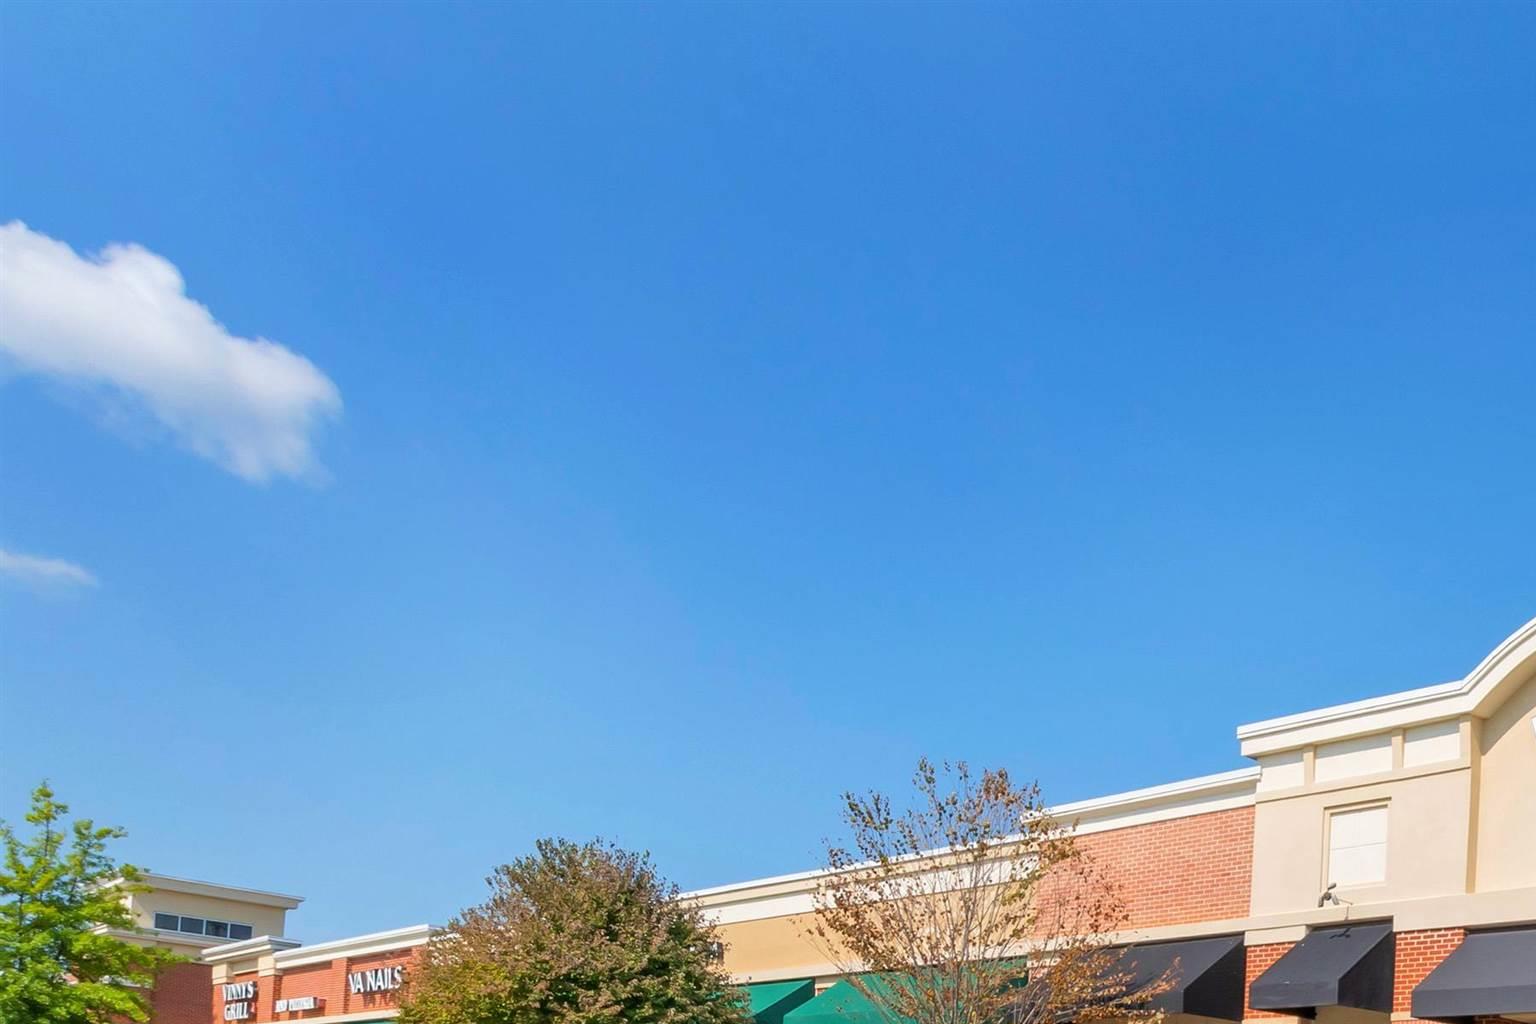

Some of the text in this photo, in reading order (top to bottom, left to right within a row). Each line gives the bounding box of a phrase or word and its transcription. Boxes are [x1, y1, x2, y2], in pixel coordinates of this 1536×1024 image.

[348, 965, 402, 994] VA NAILS
[224, 1002, 249, 1020] GRILL
